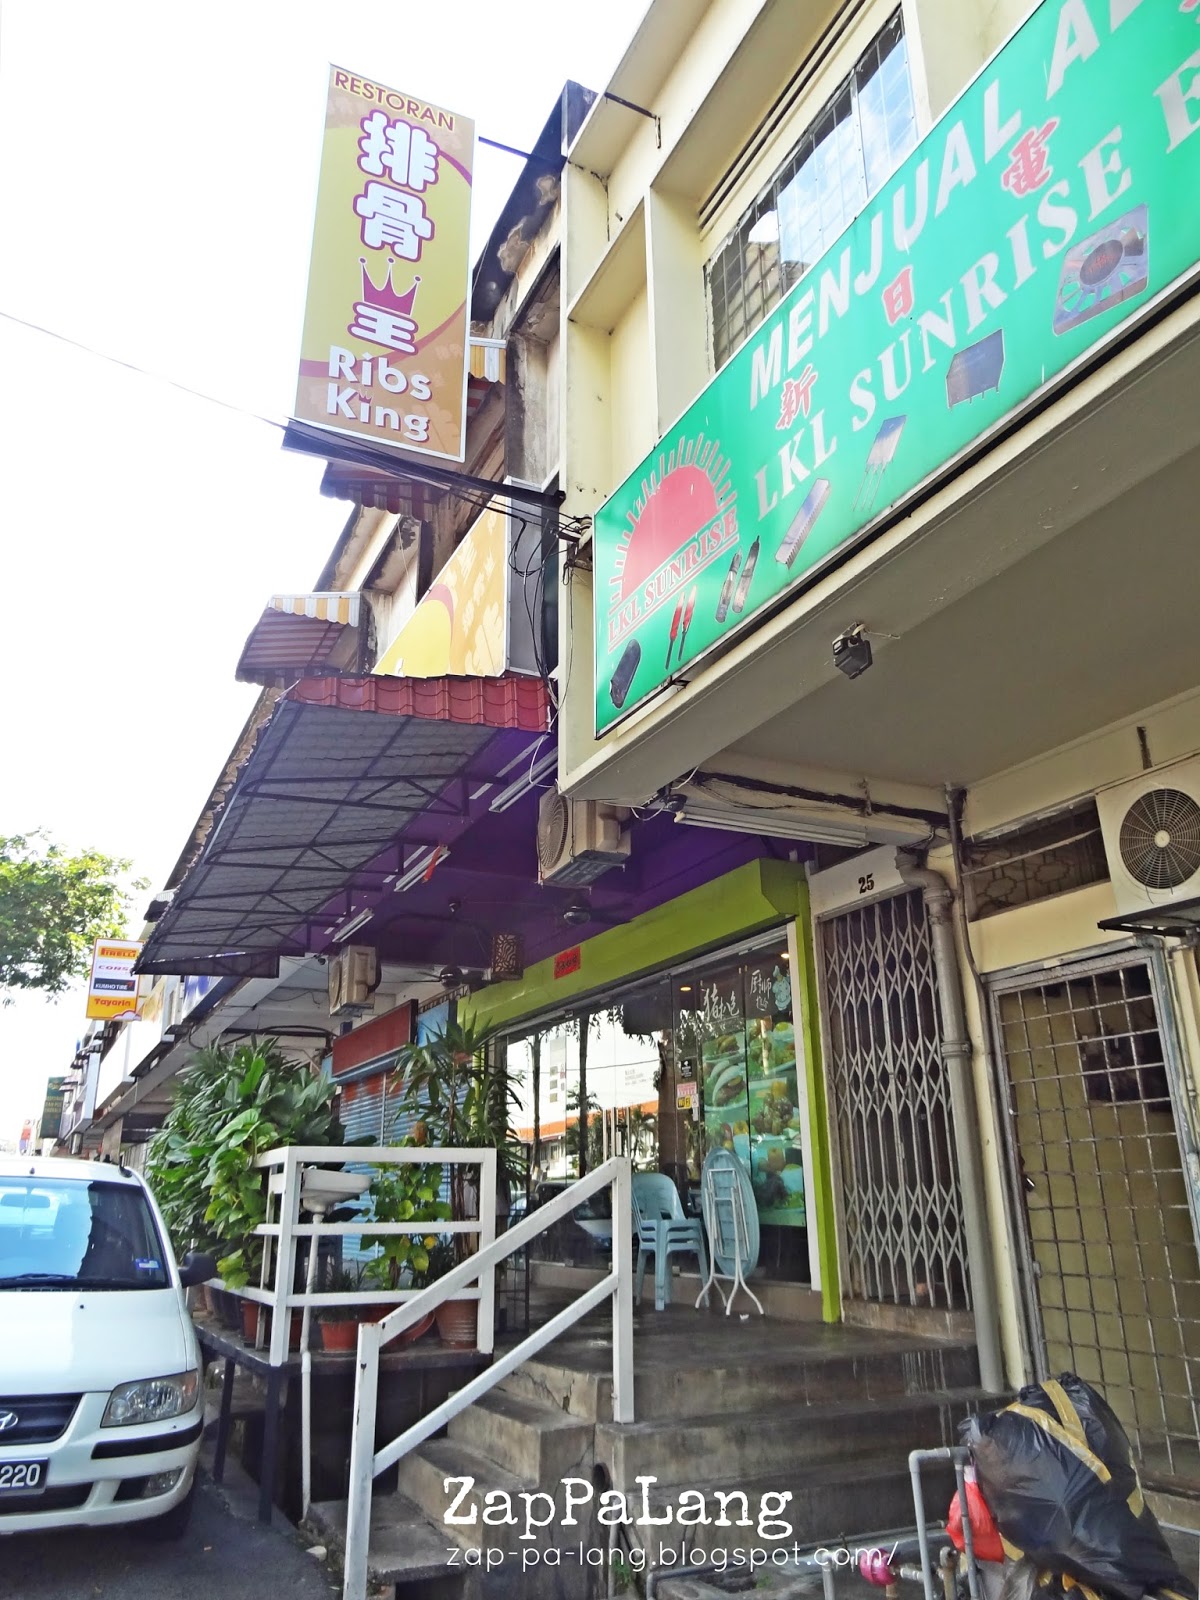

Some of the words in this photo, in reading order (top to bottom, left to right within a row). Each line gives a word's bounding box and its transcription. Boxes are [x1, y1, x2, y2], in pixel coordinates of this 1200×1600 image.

[334, 70, 455, 132] RESTORAN
[347, 109, 439, 355] 排骨王
[750, 79, 1022, 410] MENJUAL
[327, 345, 433, 401] Ribs
[754, 408, 837, 522] LKL
[849, 126, 1132, 432] SUNRISE
[776, 364, 818, 430] 新
[883, 266, 914, 326] 日
[326, 382, 429, 443] King
[607, 604, 641, 643] LKL
[643, 505, 738, 606] SUNRISE
[858, 873, 874, 894] 25
